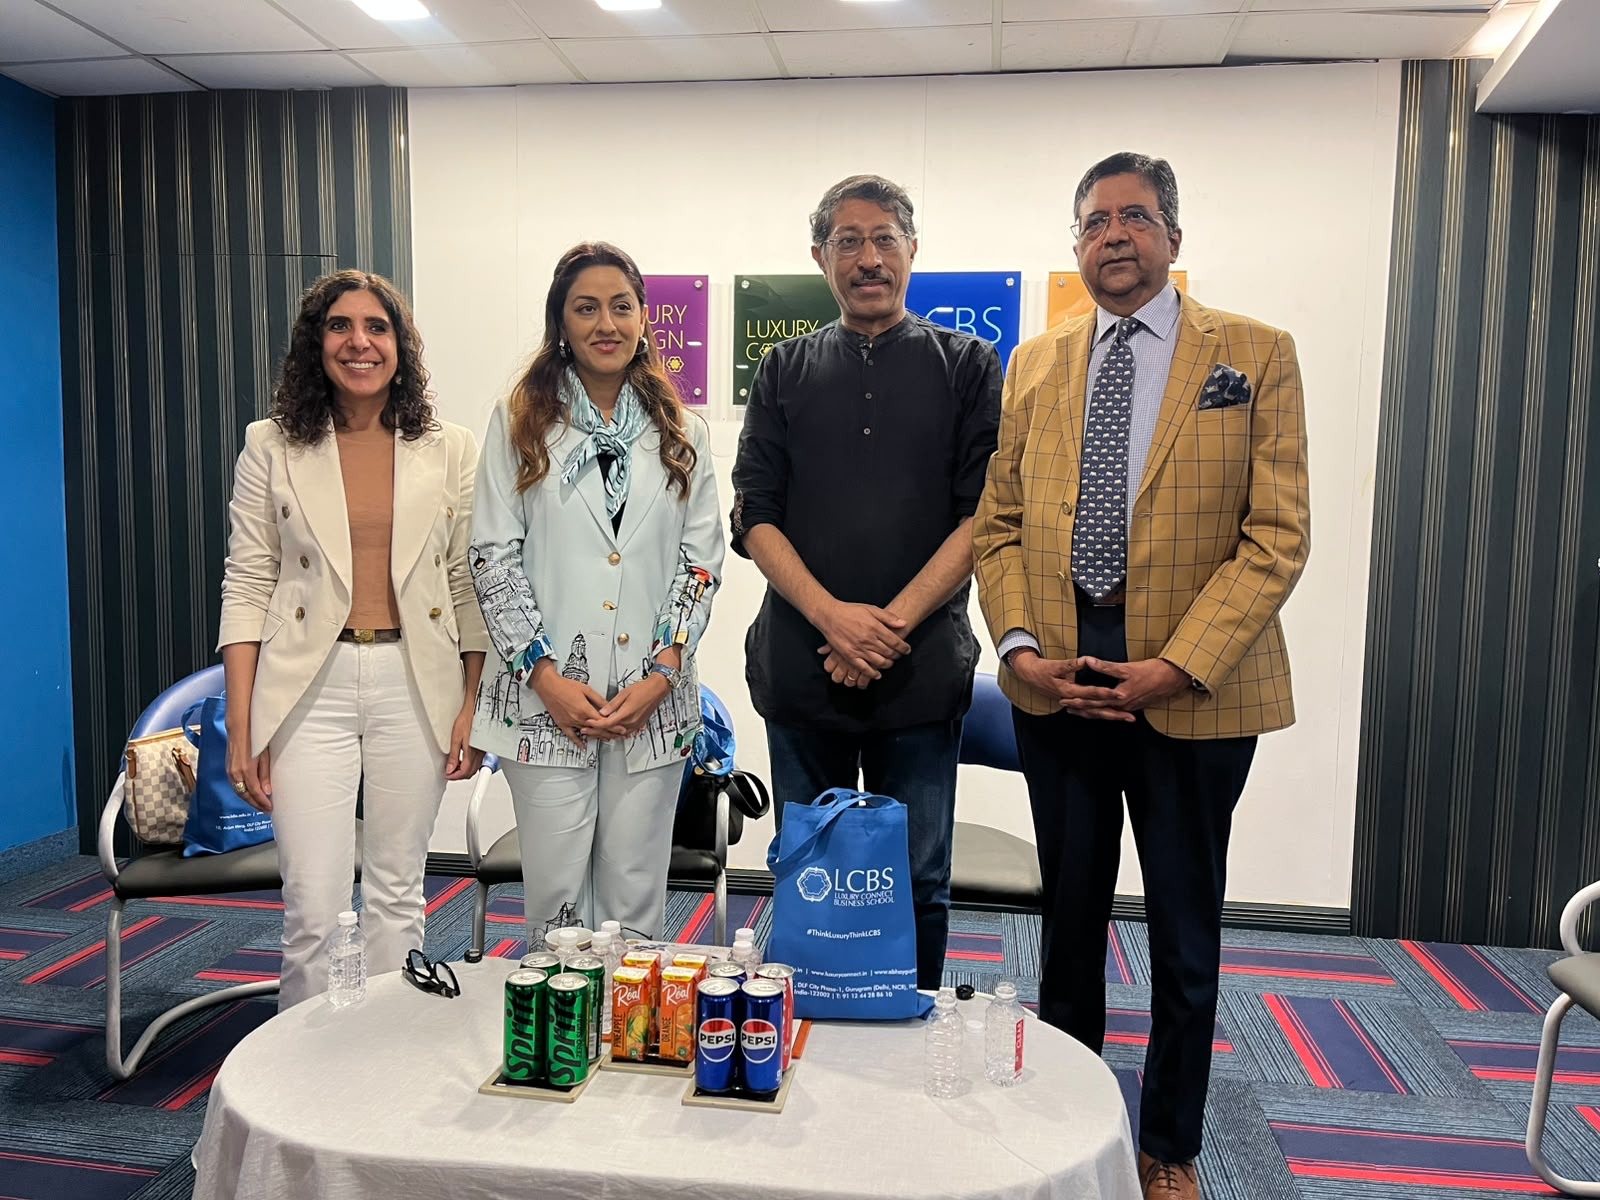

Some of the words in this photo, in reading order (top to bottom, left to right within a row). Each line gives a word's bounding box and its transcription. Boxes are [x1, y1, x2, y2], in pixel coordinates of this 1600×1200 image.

[646, 304, 688, 325] URY
[746, 319, 819, 338] LUXURY
[834, 867, 894, 893] LCBS
[833, 899, 865, 907] BUSINESS
[866, 897, 895, 906] SCHOOL
[834, 892, 860, 900] LUXURY
[861, 890, 893, 900] CONNECT
[806, 928, 881, 940] #ThinkLuxuryThinkLCBS
[506, 986, 538, 1077] Sprite
[548, 990, 581, 1083] Sprite
[700, 1033, 735, 1045] PEPSI
[742, 1033, 776, 1046] PEPSI
